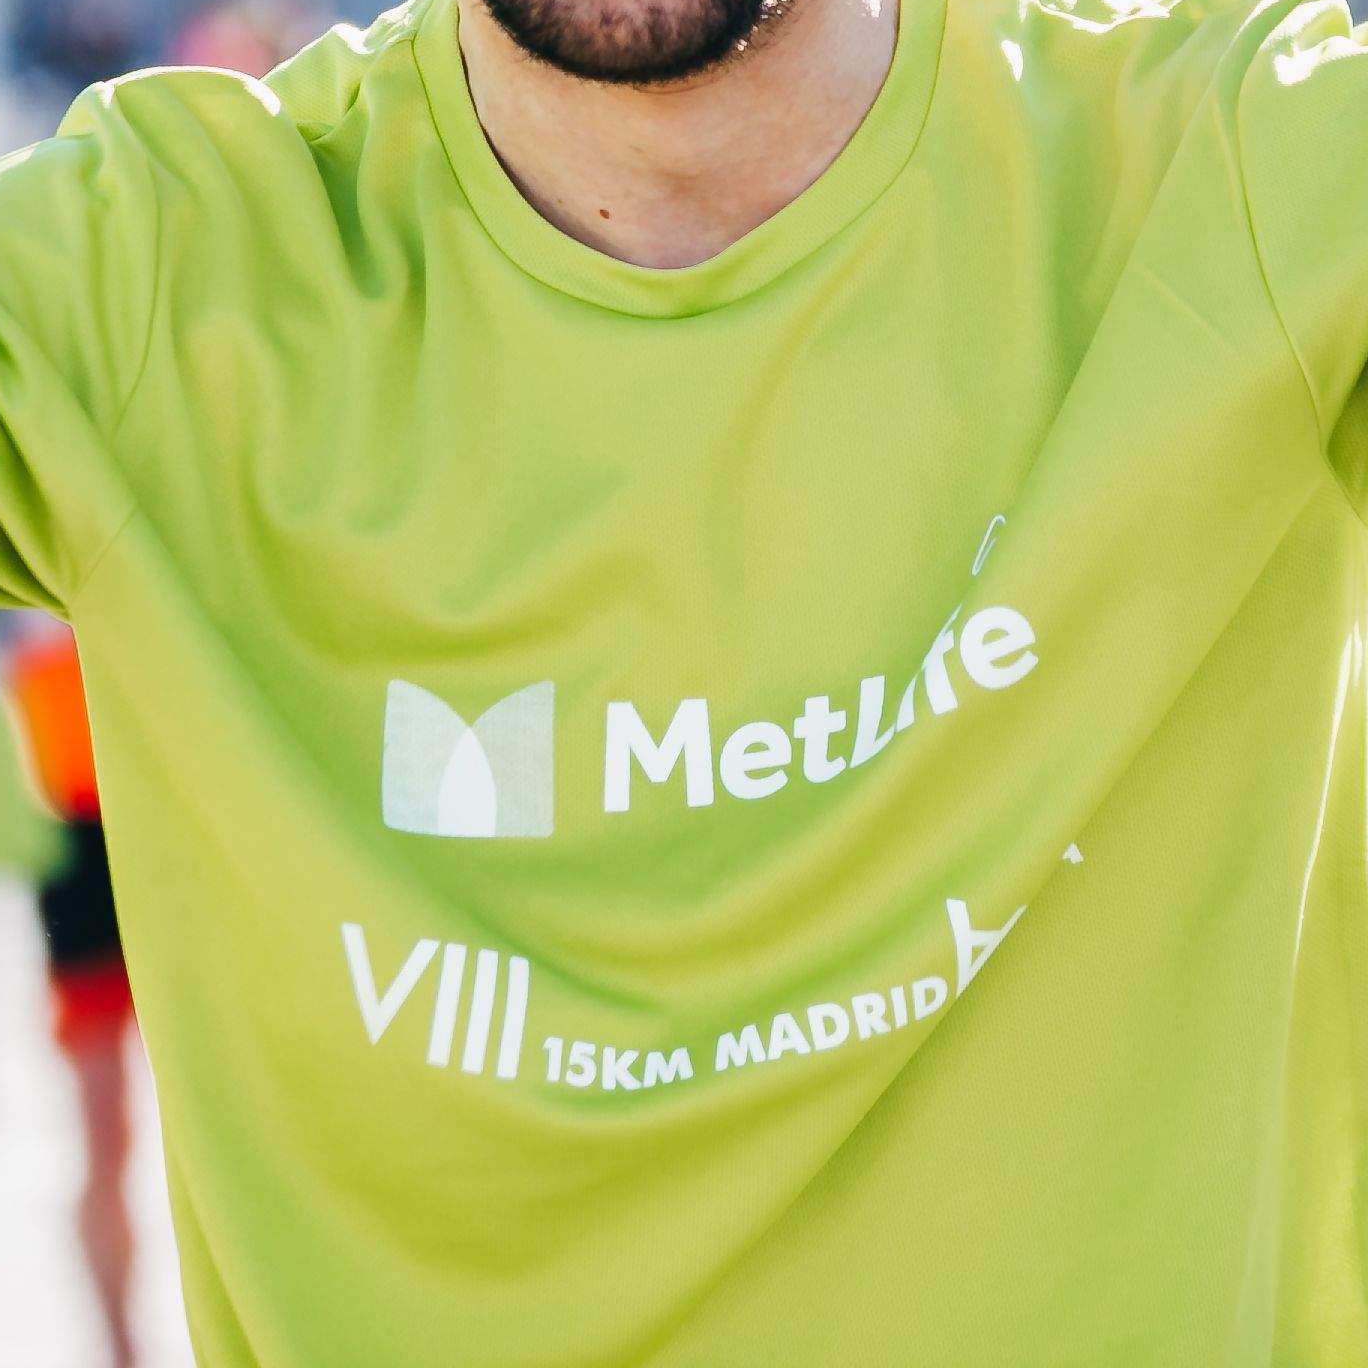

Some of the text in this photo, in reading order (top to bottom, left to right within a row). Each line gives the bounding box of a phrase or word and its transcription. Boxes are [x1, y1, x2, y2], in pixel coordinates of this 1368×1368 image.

[341, 922, 948, 1091] VIII 15KM MADRID
